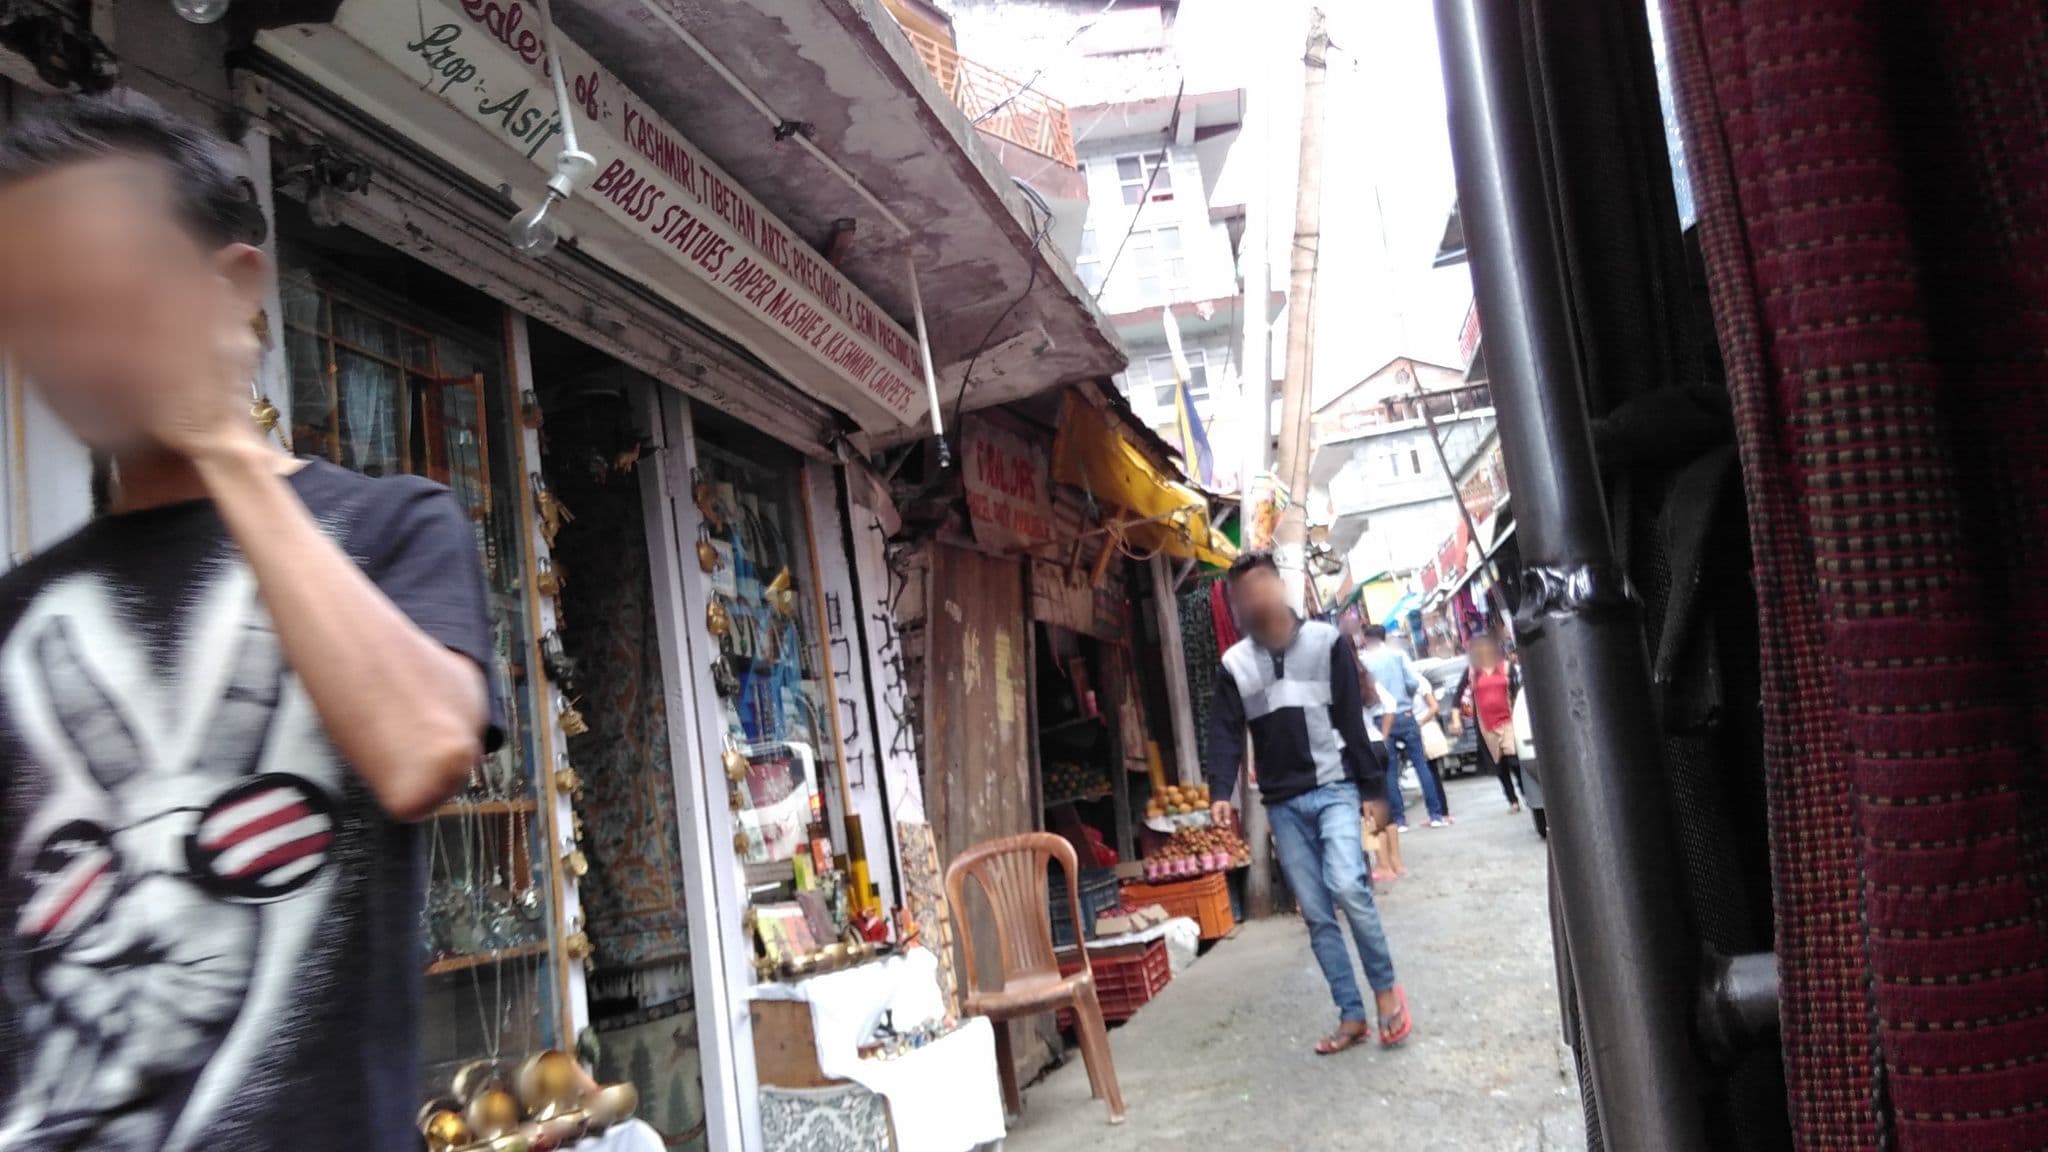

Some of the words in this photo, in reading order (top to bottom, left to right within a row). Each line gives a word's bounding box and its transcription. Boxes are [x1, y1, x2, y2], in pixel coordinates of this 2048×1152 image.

[592, 158, 665, 221] BRASS
[699, 165, 755, 244] TIBETAN
[651, 204, 735, 281] STATUES,
[721, 256, 777, 307] PAPER
[763, 287, 823, 340] MASHIE
[811, 323, 832, 348] &
[821, 331, 878, 383] KASHMIRI
